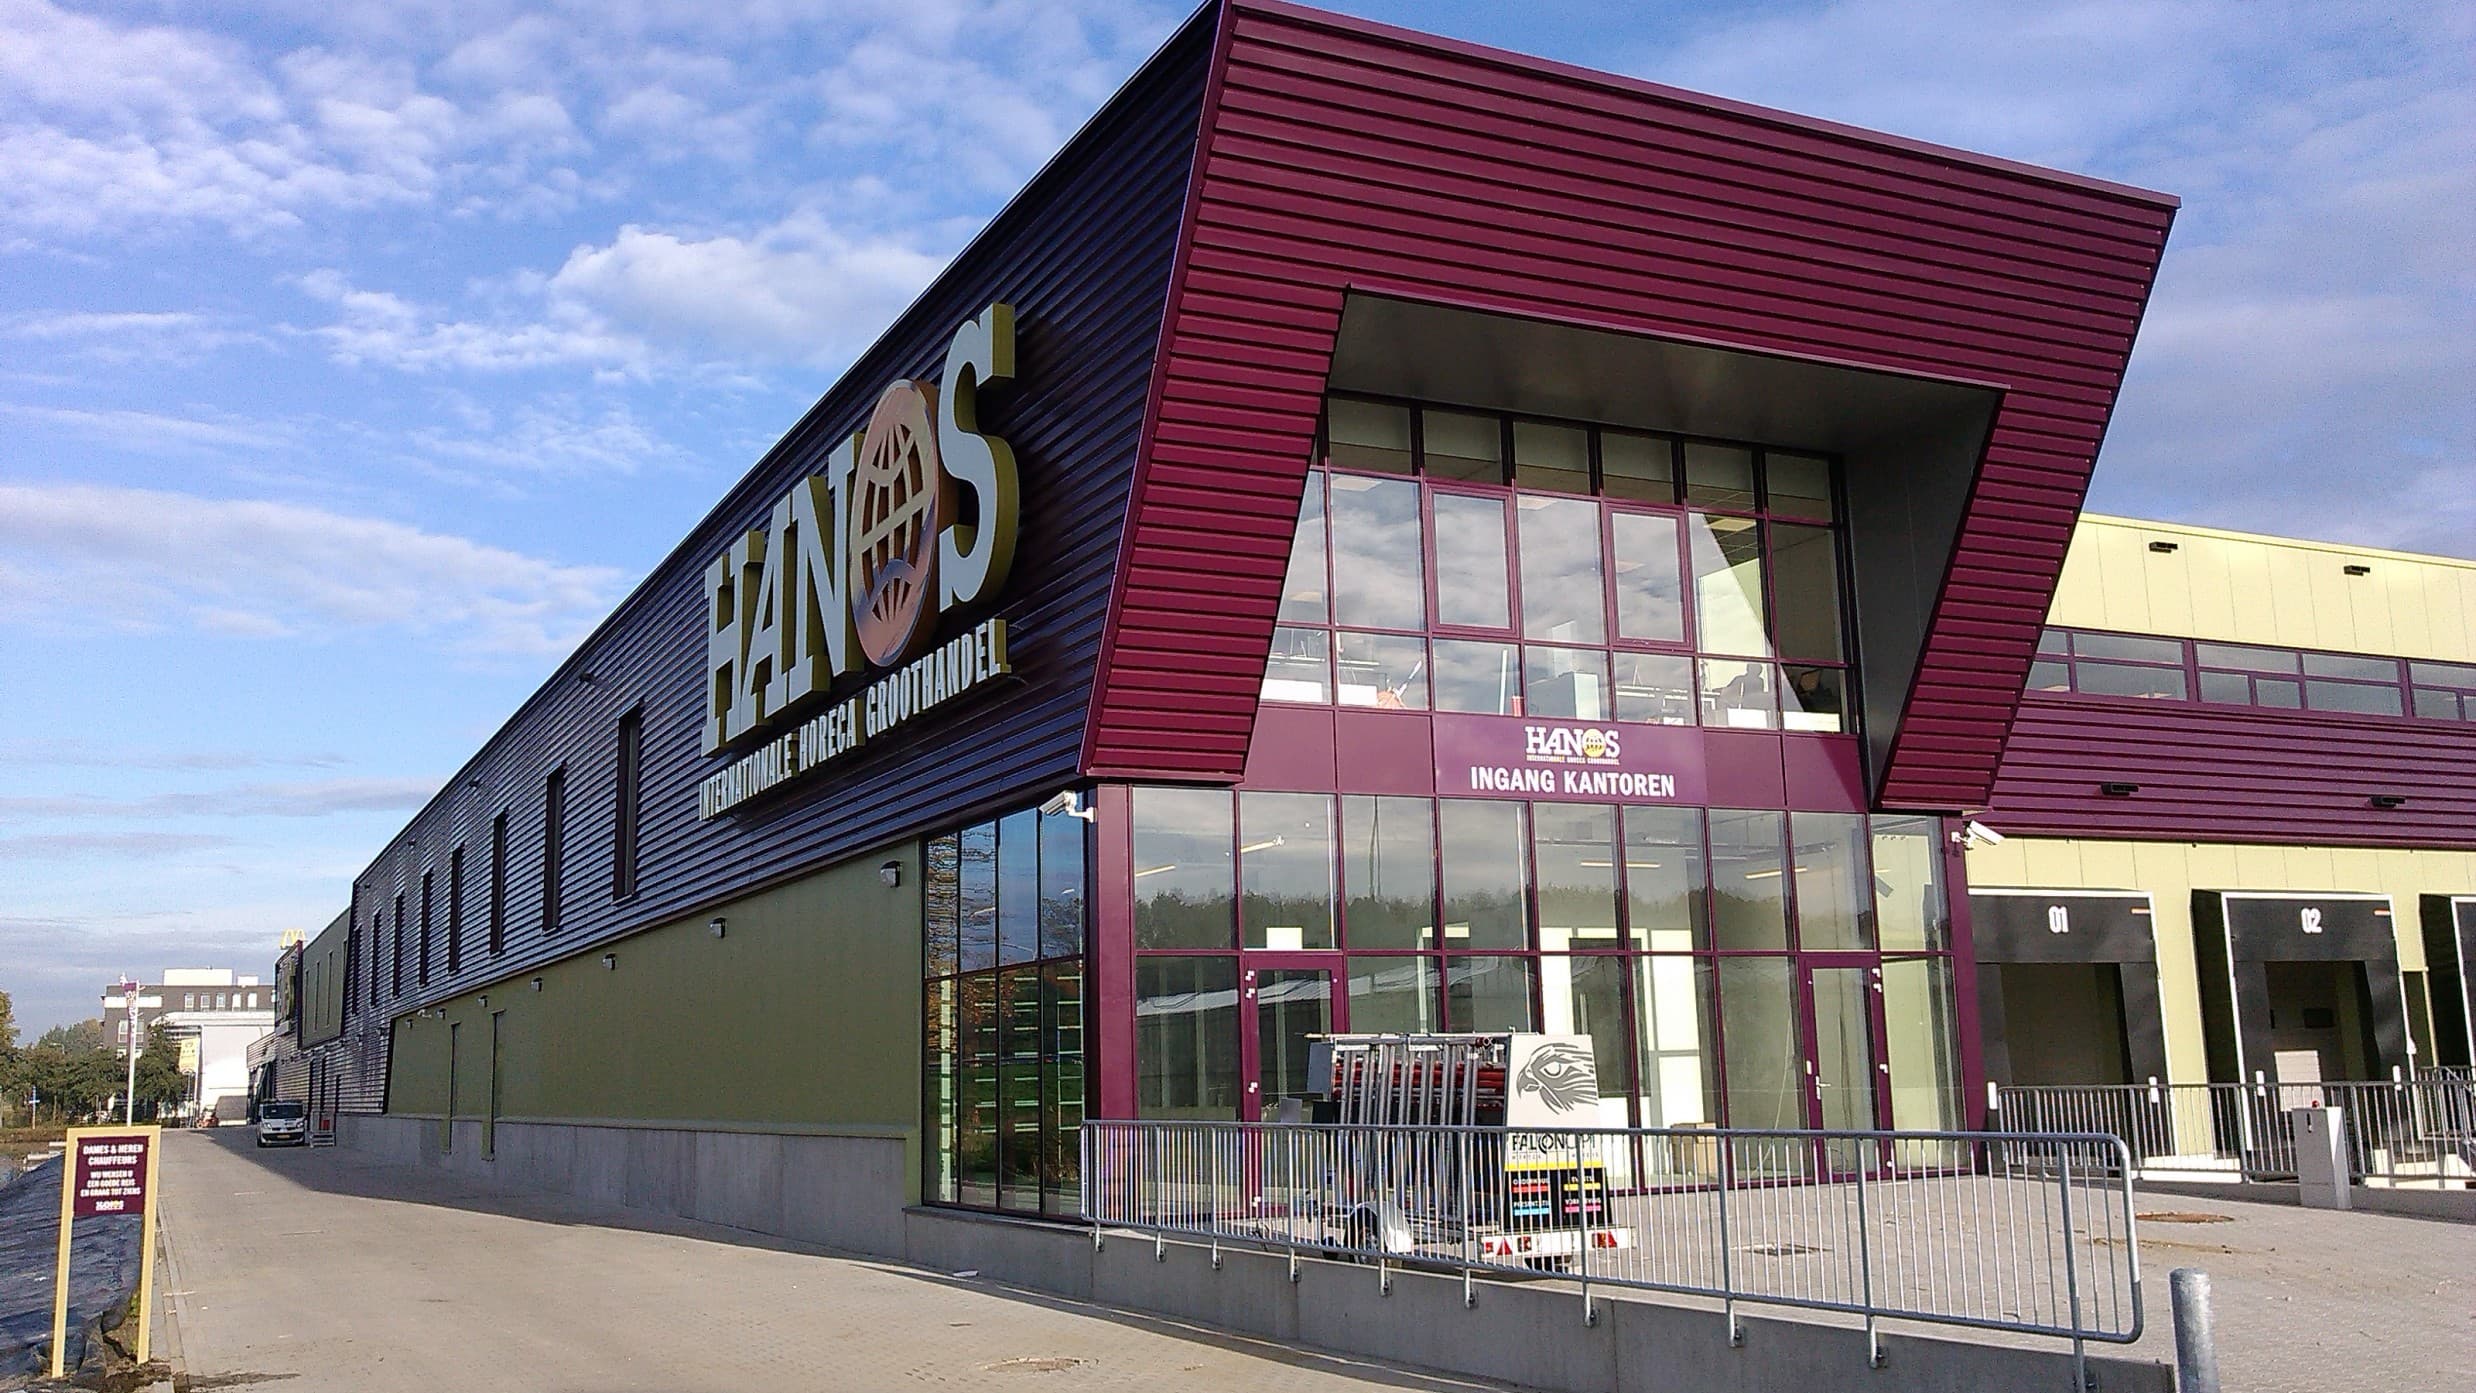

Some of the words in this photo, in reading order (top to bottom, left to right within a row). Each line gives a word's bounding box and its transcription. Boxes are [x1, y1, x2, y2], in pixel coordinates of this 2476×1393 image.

[702, 303, 1018, 757] HANOS
[699, 733, 796, 821] INTERNATIONALE
[799, 698, 864, 771] HORECA
[866, 619, 1010, 738] GROOTHANDEL
[1525, 726, 1620, 758] HANOS
[1471, 767, 1555, 793] INGANG
[1564, 770, 1675, 798] KANTOREN
[2048, 905, 2070, 934] 01
[2301, 907, 2323, 934] 02
[83, 1145, 109, 1155] DAMES
[118, 1144, 143, 1153] HEREN
[88, 1156, 137, 1166] CHAUFFEURS
